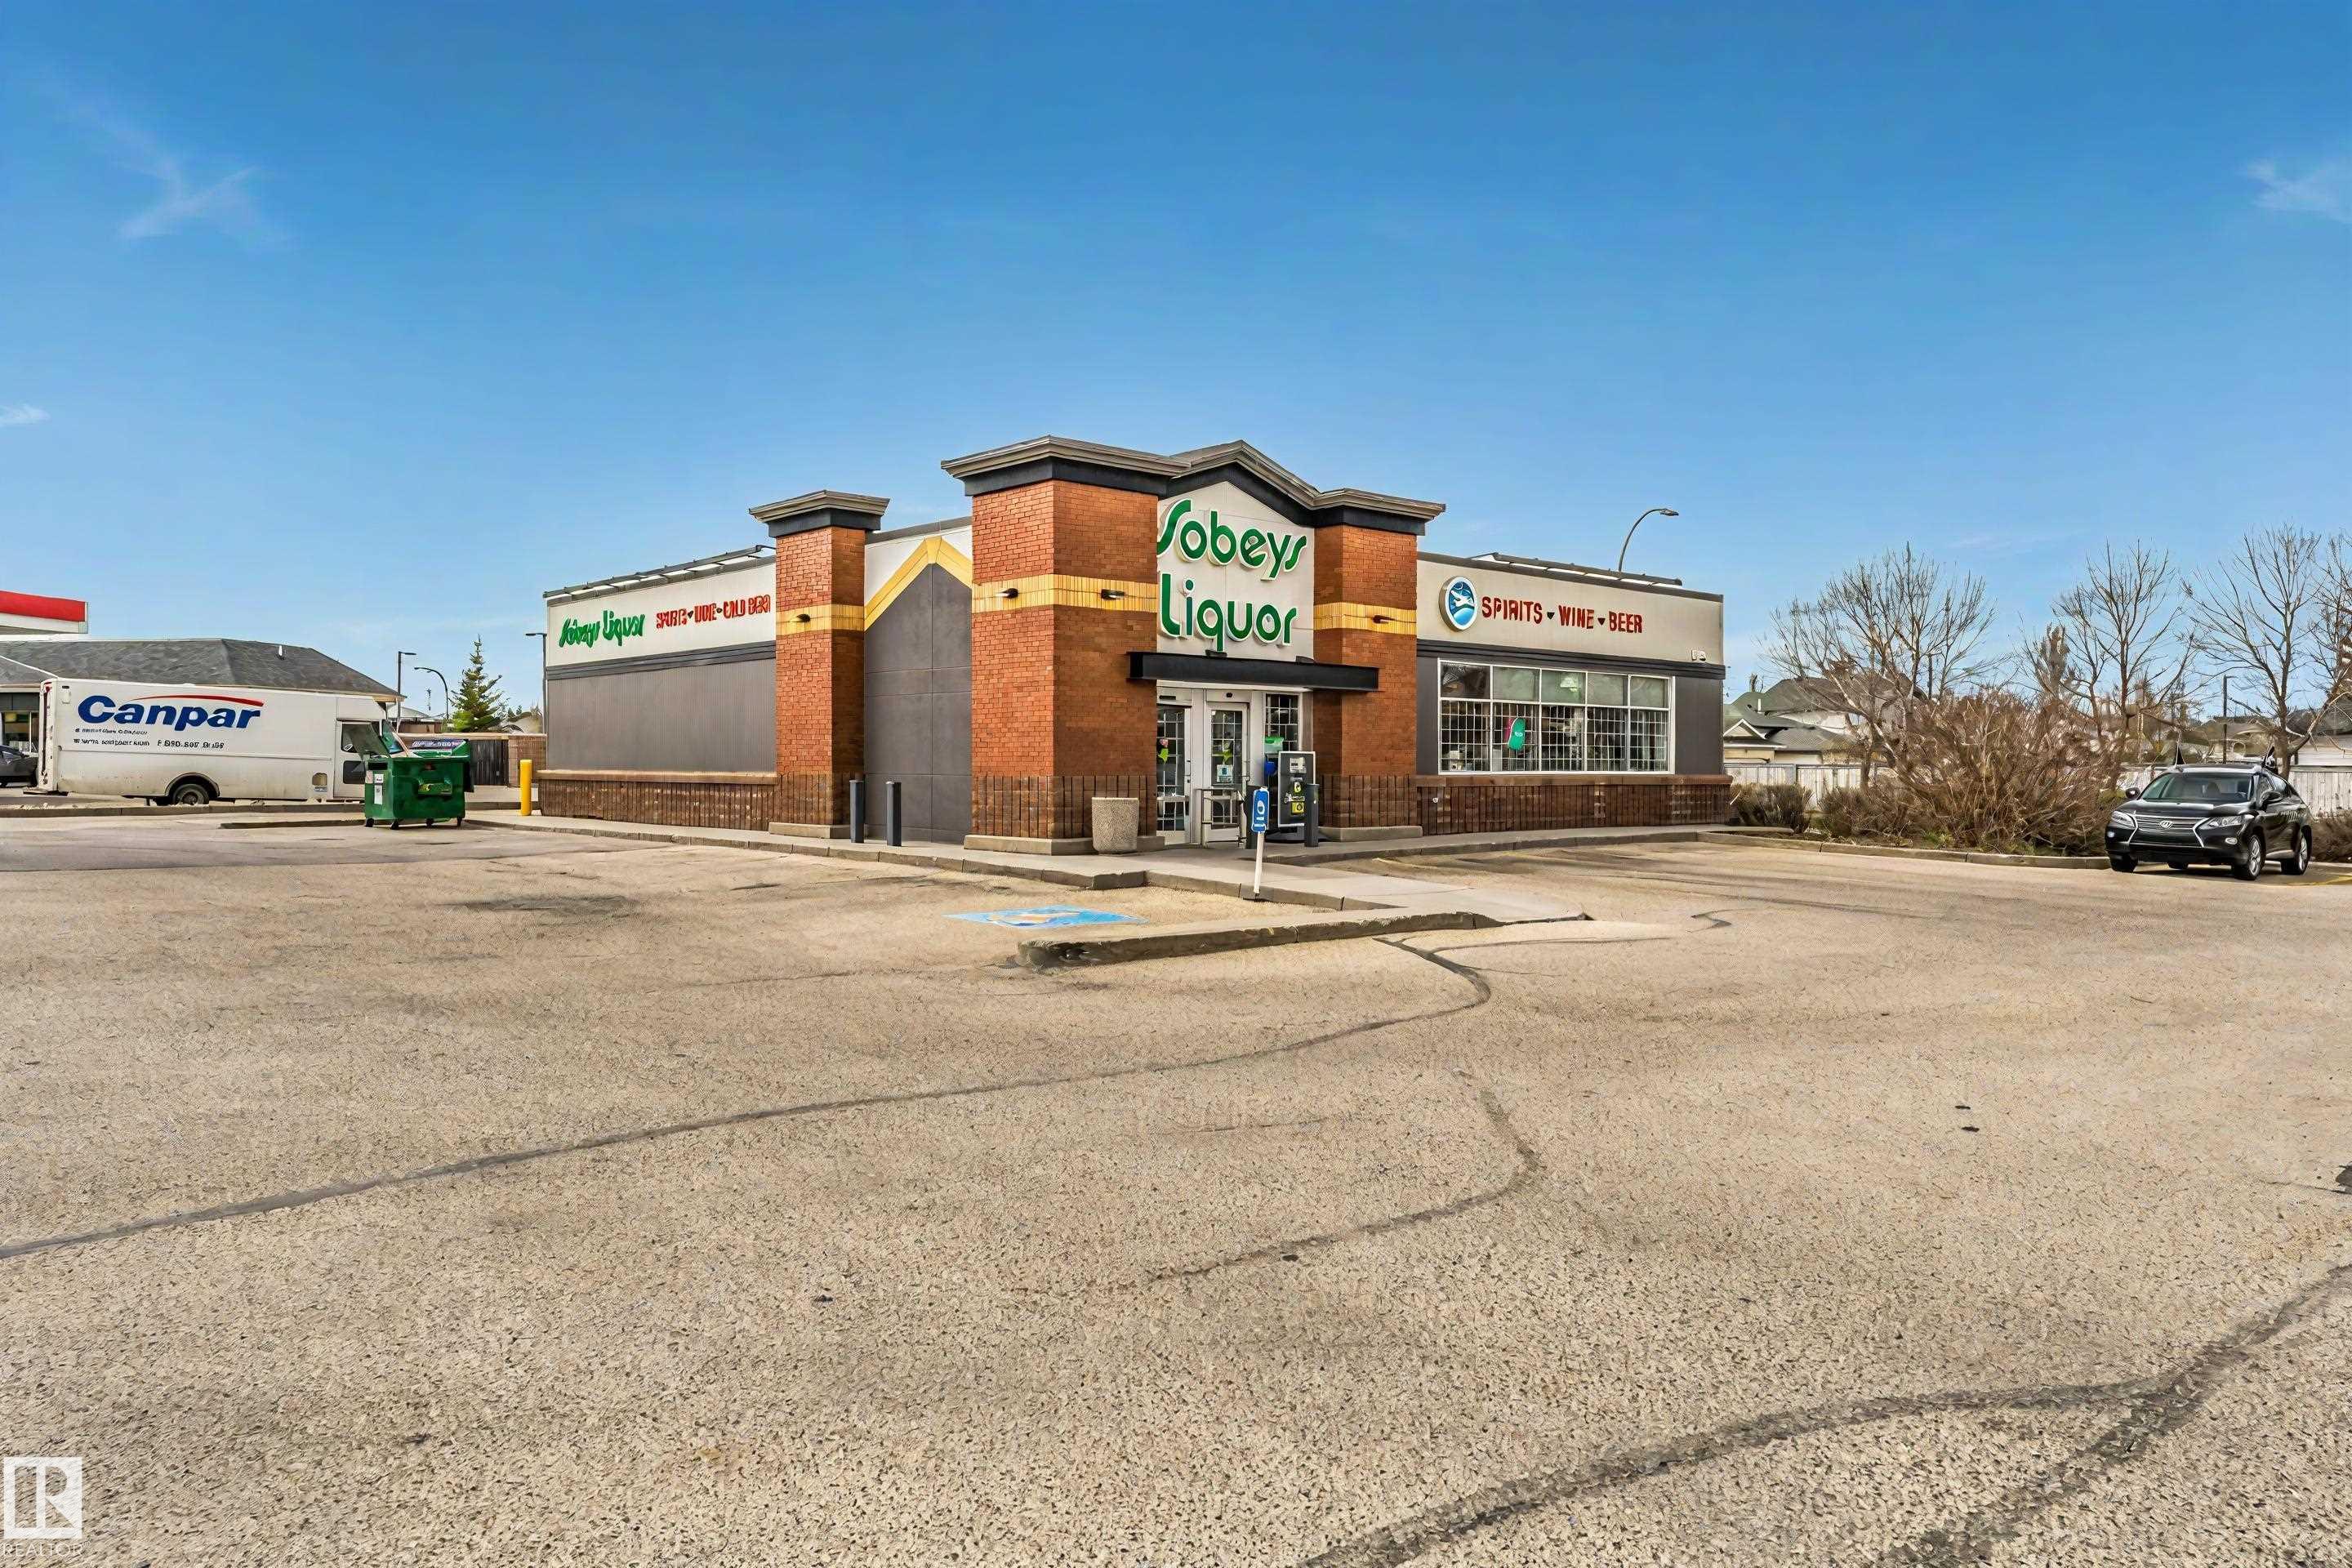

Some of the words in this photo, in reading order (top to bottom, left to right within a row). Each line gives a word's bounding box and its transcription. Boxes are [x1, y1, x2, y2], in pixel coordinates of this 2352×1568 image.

[1156, 498, 1307, 579] Sobeys
[1160, 572, 1298, 653] Liquor
[1481, 596, 1543, 624] SPIRITS
[1558, 604, 1595, 630] WINE
[1608, 611, 1642, 634] BEER
[78, 695, 261, 731] Canpar
